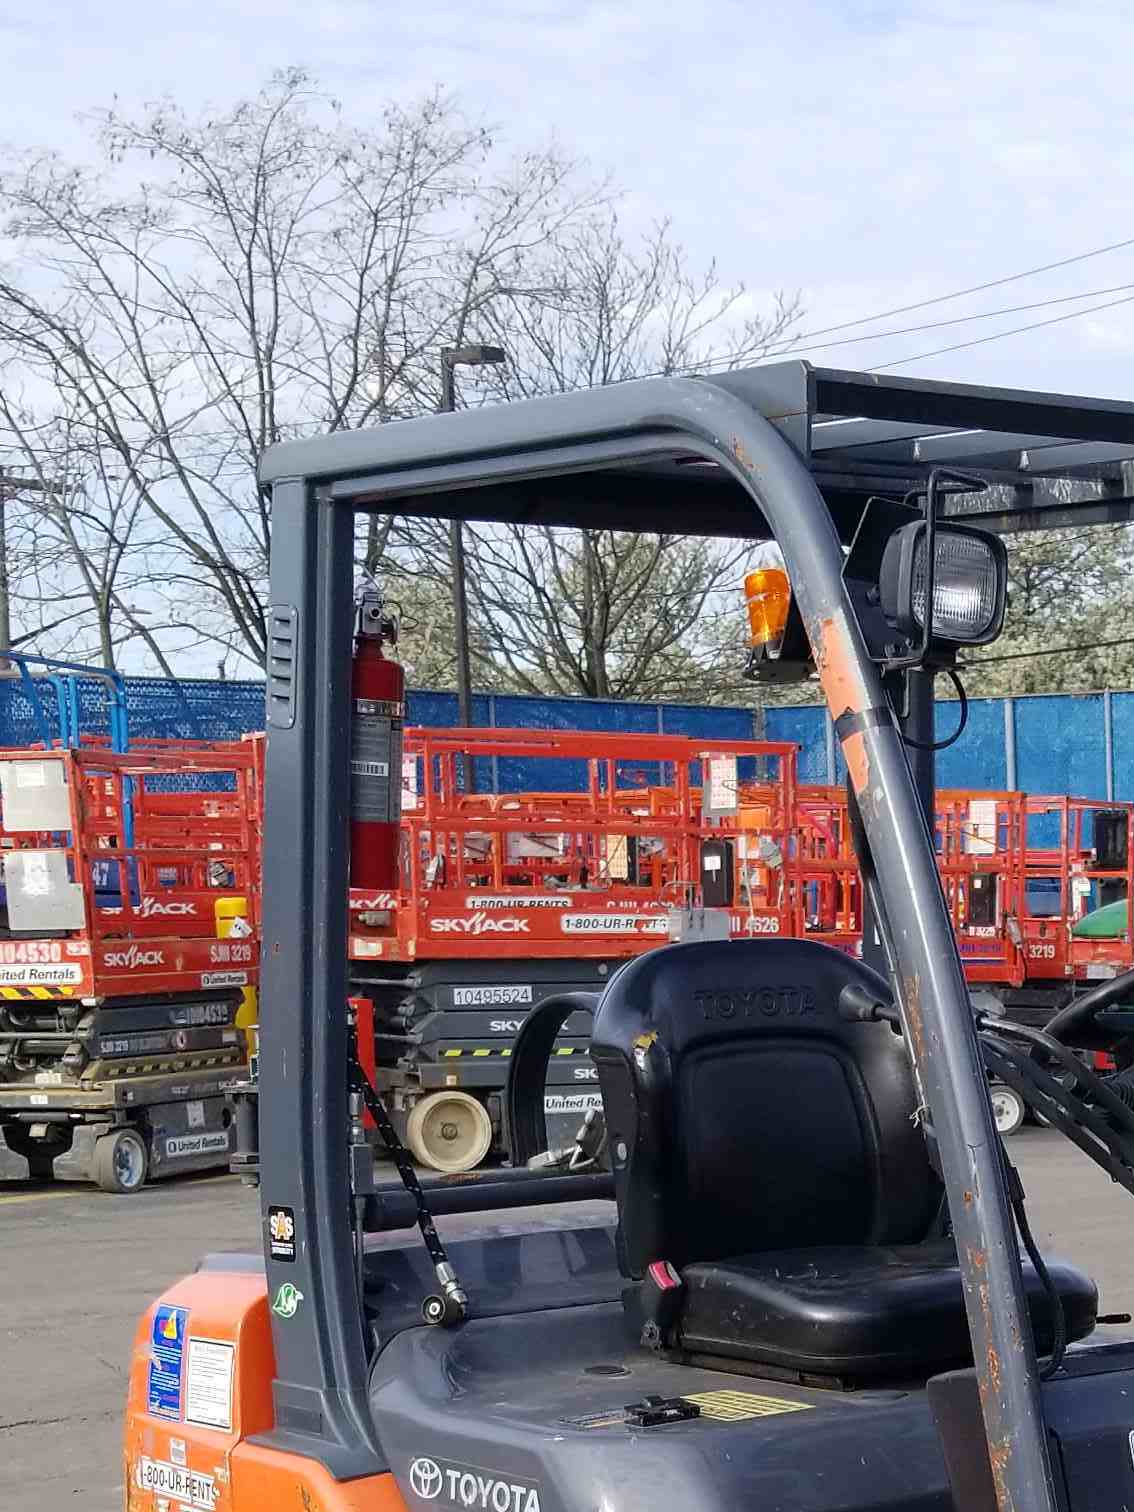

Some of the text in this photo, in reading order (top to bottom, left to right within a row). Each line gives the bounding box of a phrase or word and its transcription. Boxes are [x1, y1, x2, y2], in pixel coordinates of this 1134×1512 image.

[430, 911, 531, 935] SKYJACK
[104, 944, 164, 968] SKYJACK
[1029, 944, 1055, 959] 3219
[0, 967, 75, 980] ited Rentals
[455, 988, 529, 1005] 10495524
[694, 986, 818, 1020] TOYOTA
[490, 1019, 568, 1032] SKYK
[546, 1097, 584, 1110] United
[142, 1461, 218, 1501] -800-UR-RENTS
